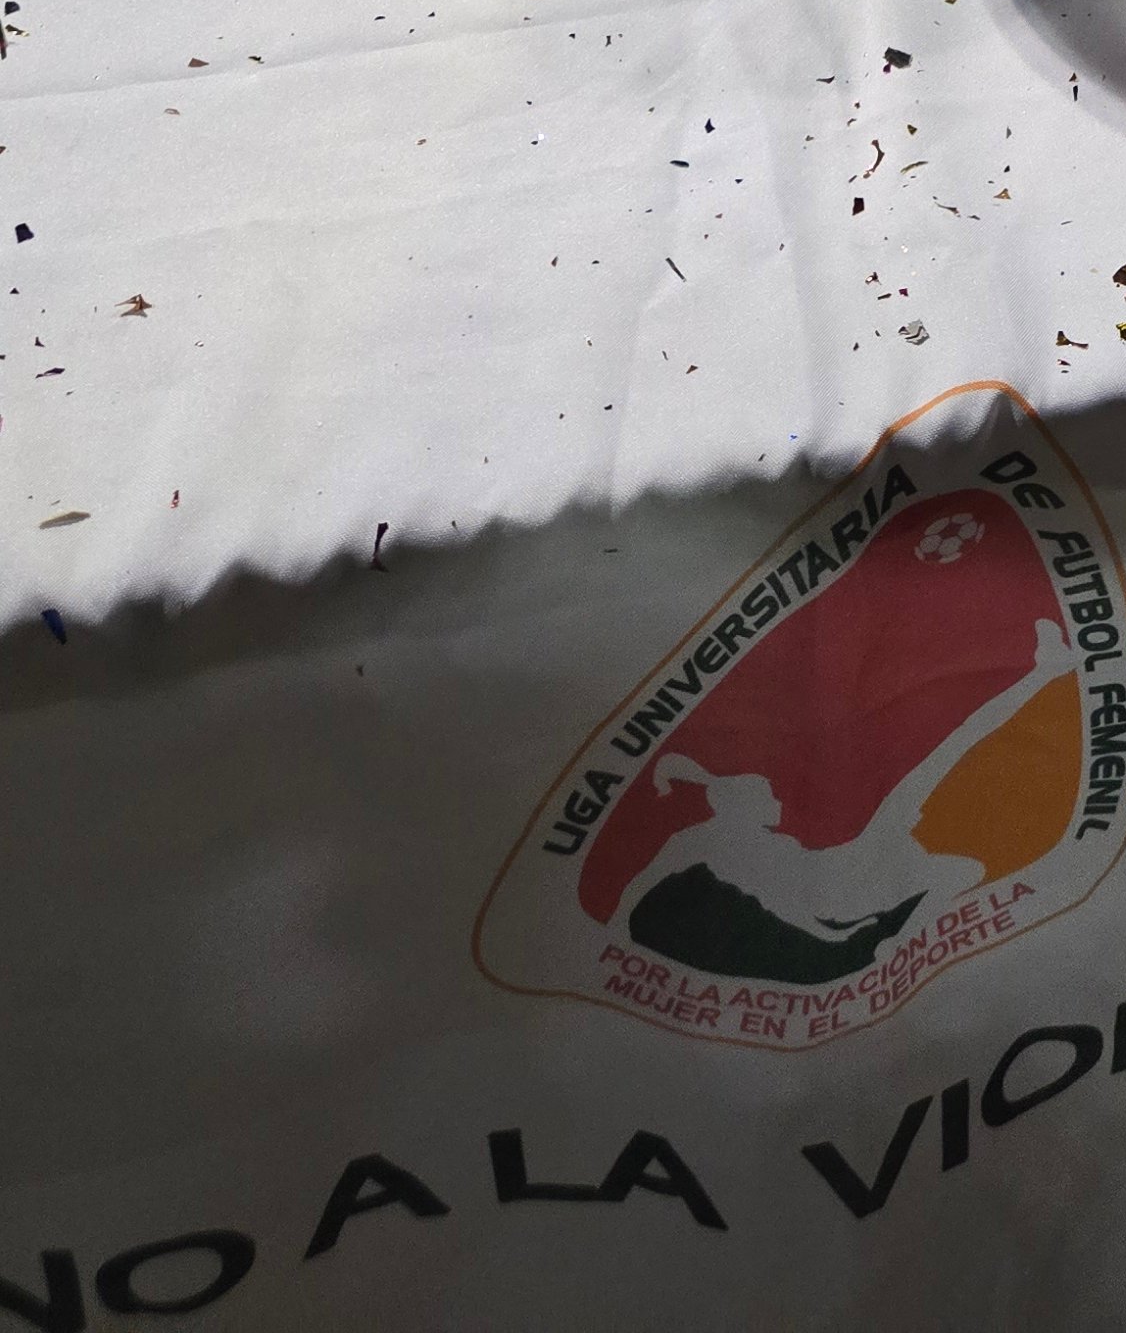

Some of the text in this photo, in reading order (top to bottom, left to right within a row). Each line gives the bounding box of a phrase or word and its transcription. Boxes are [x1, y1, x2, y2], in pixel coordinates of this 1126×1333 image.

[979, 450, 1064, 513] DE
[1038, 526, 1124, 673] FUTBOL
[542, 464, 925, 855] LIGA UNIVERSITARIA
[599, 881, 1037, 1015] POR LA ACTIVACIÓN DE LA
[604, 909, 1016, 1037] MUJER EN EL DEPORTE
[303, 1153, 453, 1262] A
[488, 1127, 730, 1231] LA
